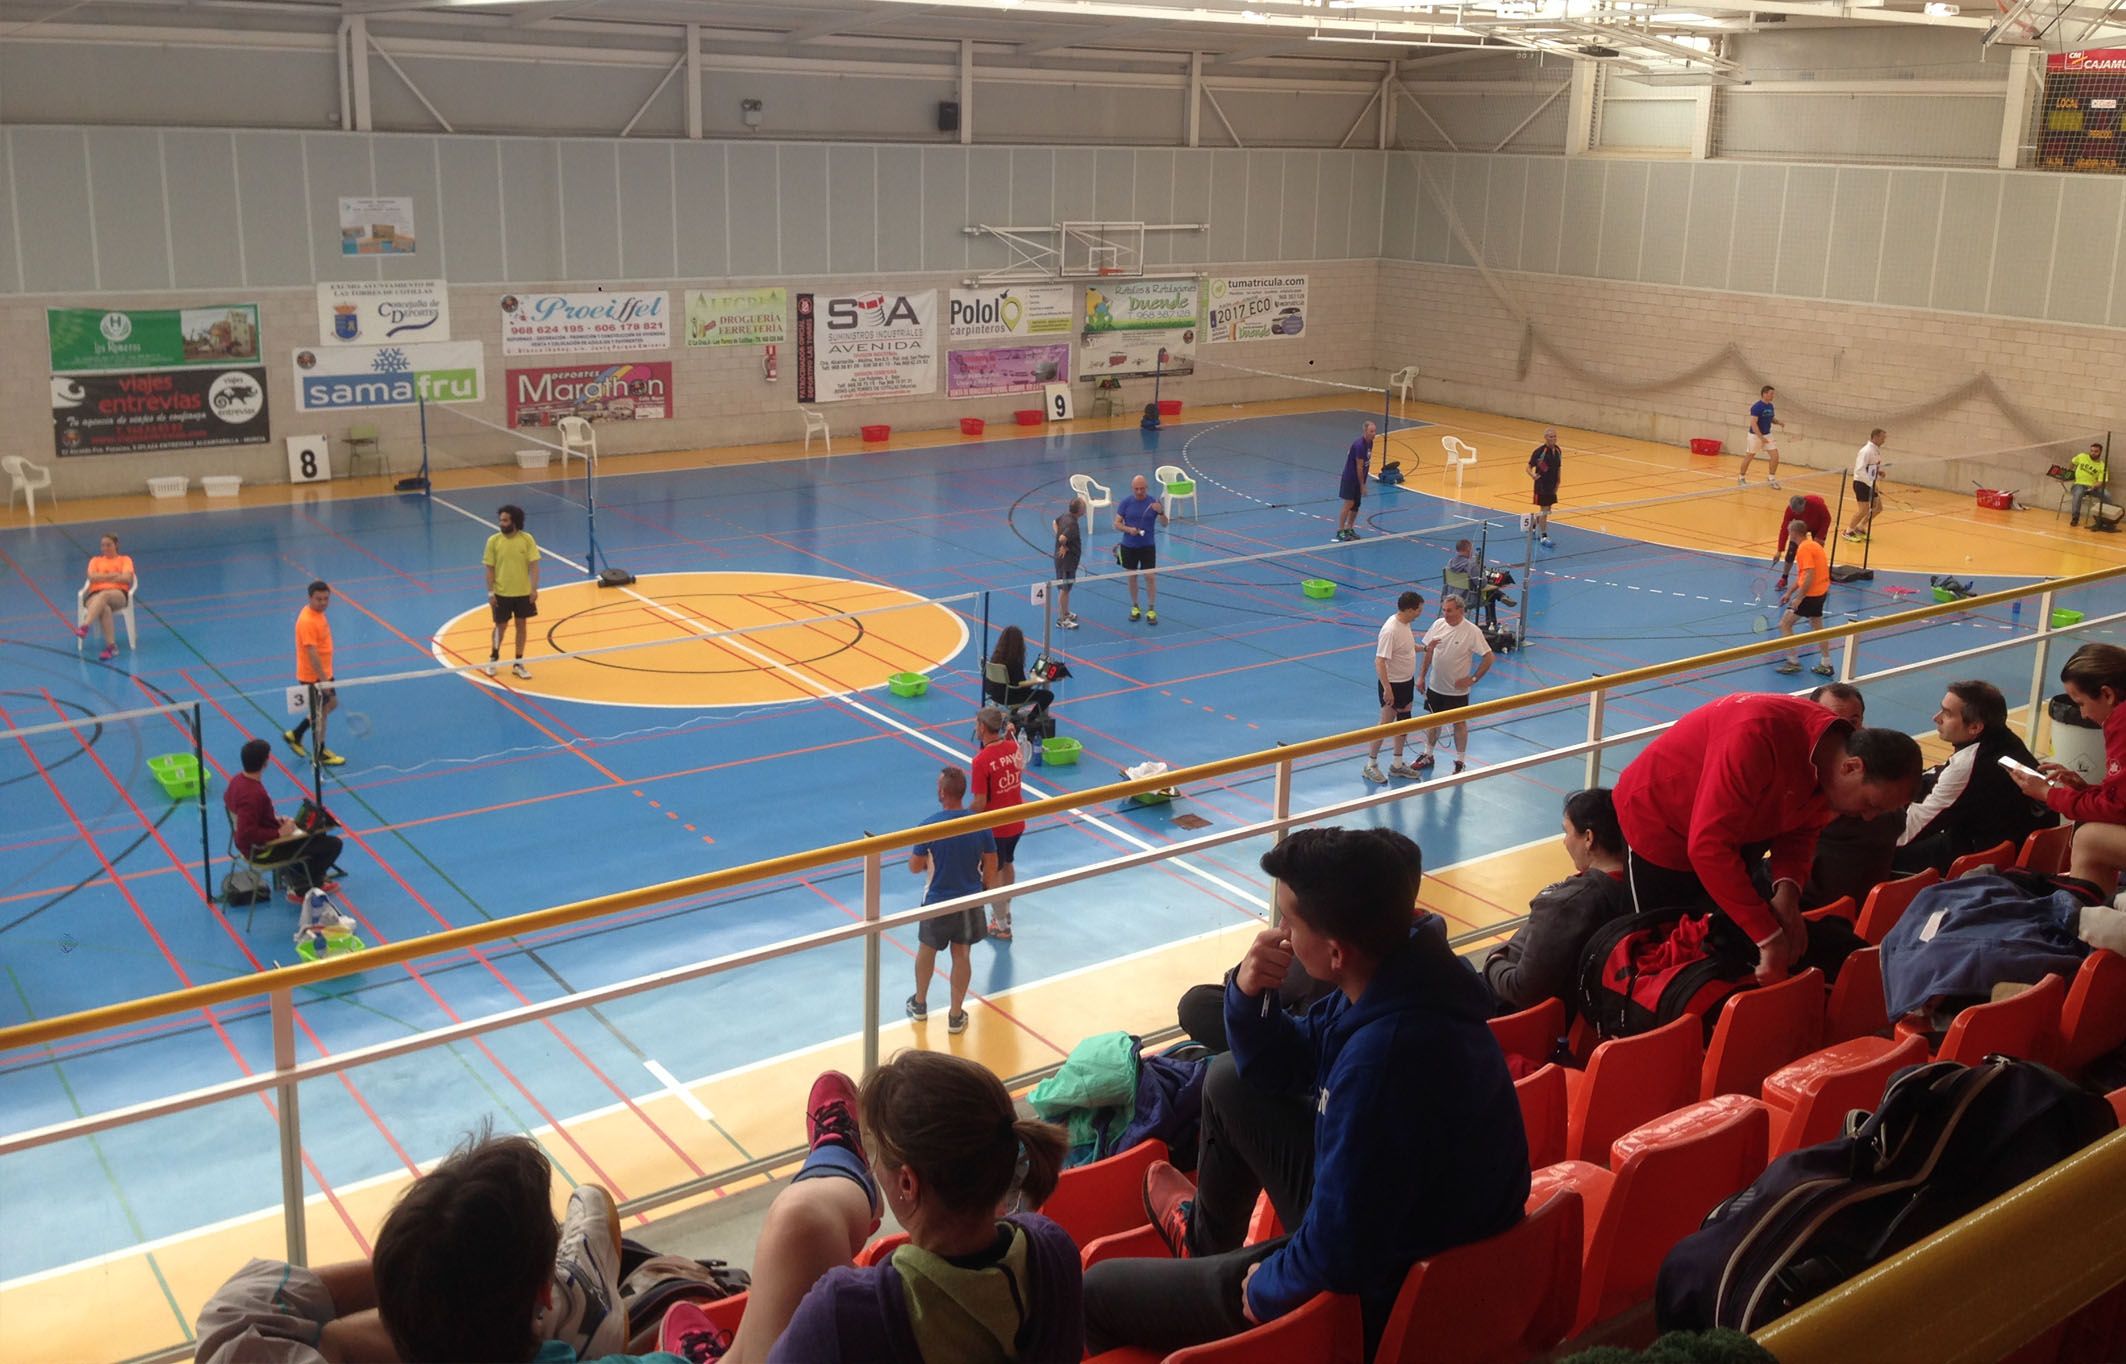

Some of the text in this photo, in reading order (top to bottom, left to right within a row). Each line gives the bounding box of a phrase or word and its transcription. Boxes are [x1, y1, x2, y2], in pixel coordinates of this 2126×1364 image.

[1228, 277, 1305, 289] tumatricula.com
[1128, 292, 1189, 311] Duende
[531, 296, 662, 323] Proeiffel
[1218, 304, 1246, 324] 2017
[1249, 298, 1271, 316] ECO
[511, 326, 533, 335] 968
[537, 325, 559, 334] 624
[564, 324, 584, 333] 195
[594, 323, 616, 332] 606
[620, 322, 640, 331] 178
[643, 321, 664, 330] 821
[951, 325, 1006, 336] carpinteros
[828, 330, 874, 341] SUMINISTROS
[829, 340, 921, 353] AVENIDA
[119, 375, 173, 394] viajes
[309, 374, 473, 405] samafru
[518, 373, 664, 403] Marathn
[1055, 394, 1066, 418] 9
[300, 449, 318, 478] 8
[1523, 518, 1530, 527] 5
[1036, 588, 1044, 599] 4
[293, 693, 305, 706] 3
[989, 761, 1000, 771] T.
